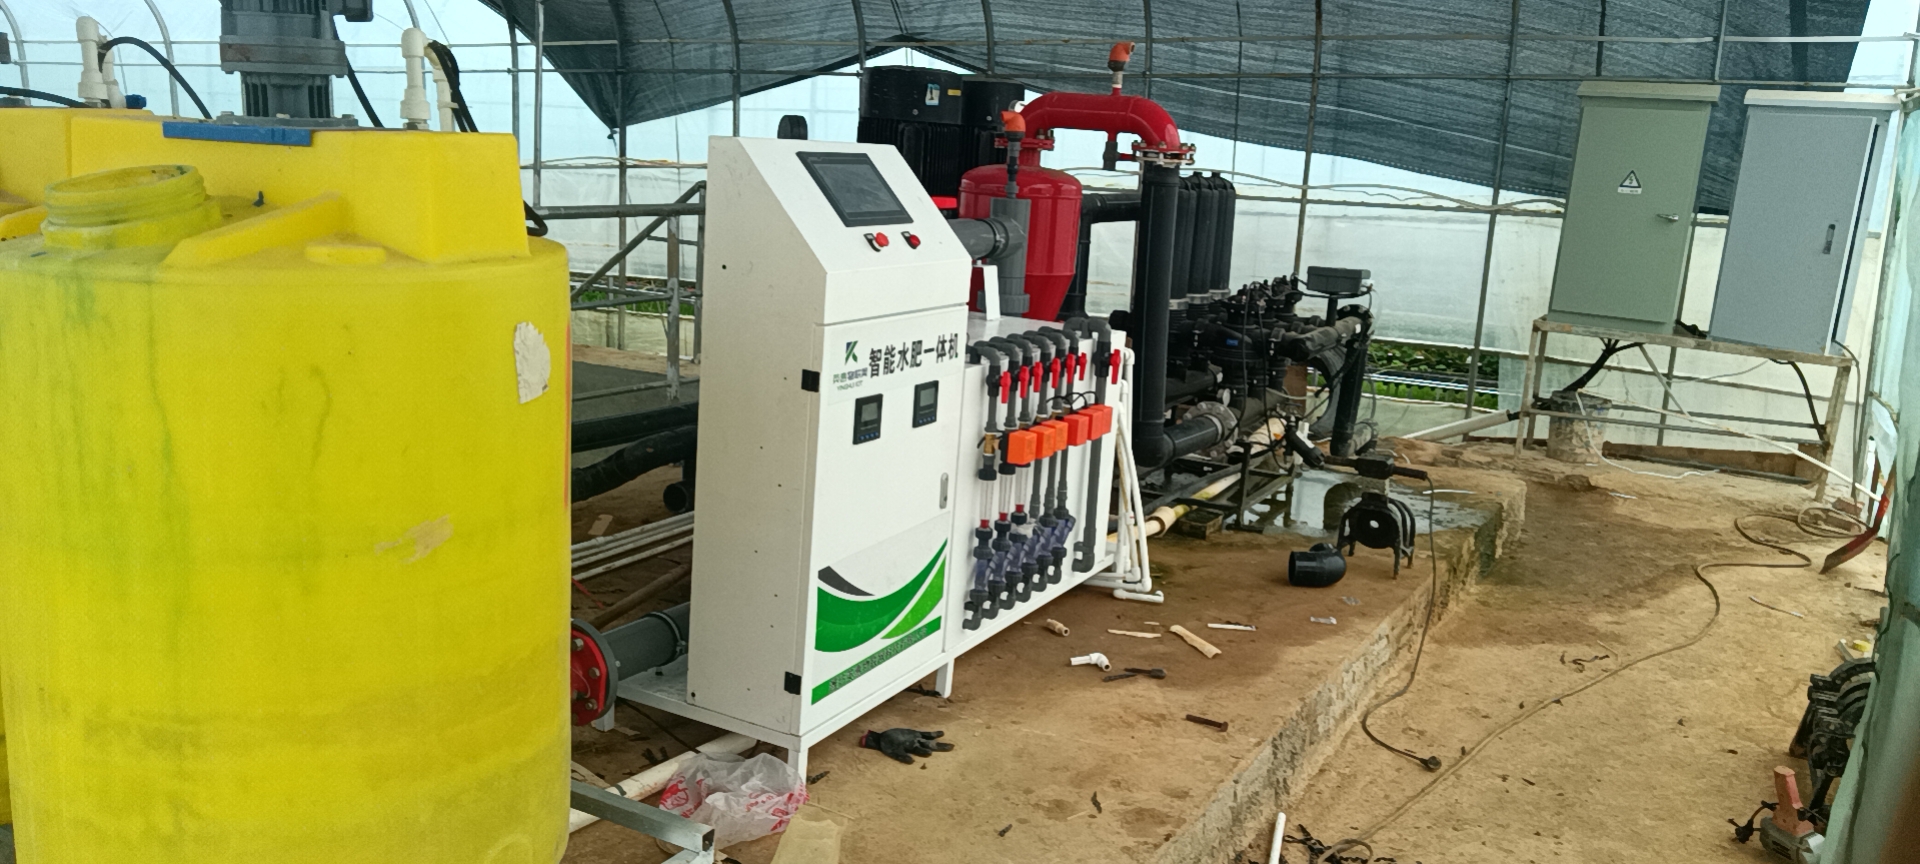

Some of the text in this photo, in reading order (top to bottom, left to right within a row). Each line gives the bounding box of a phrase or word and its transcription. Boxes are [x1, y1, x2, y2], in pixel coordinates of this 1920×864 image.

[868, 333, 958, 378] 智能水肥一体机
